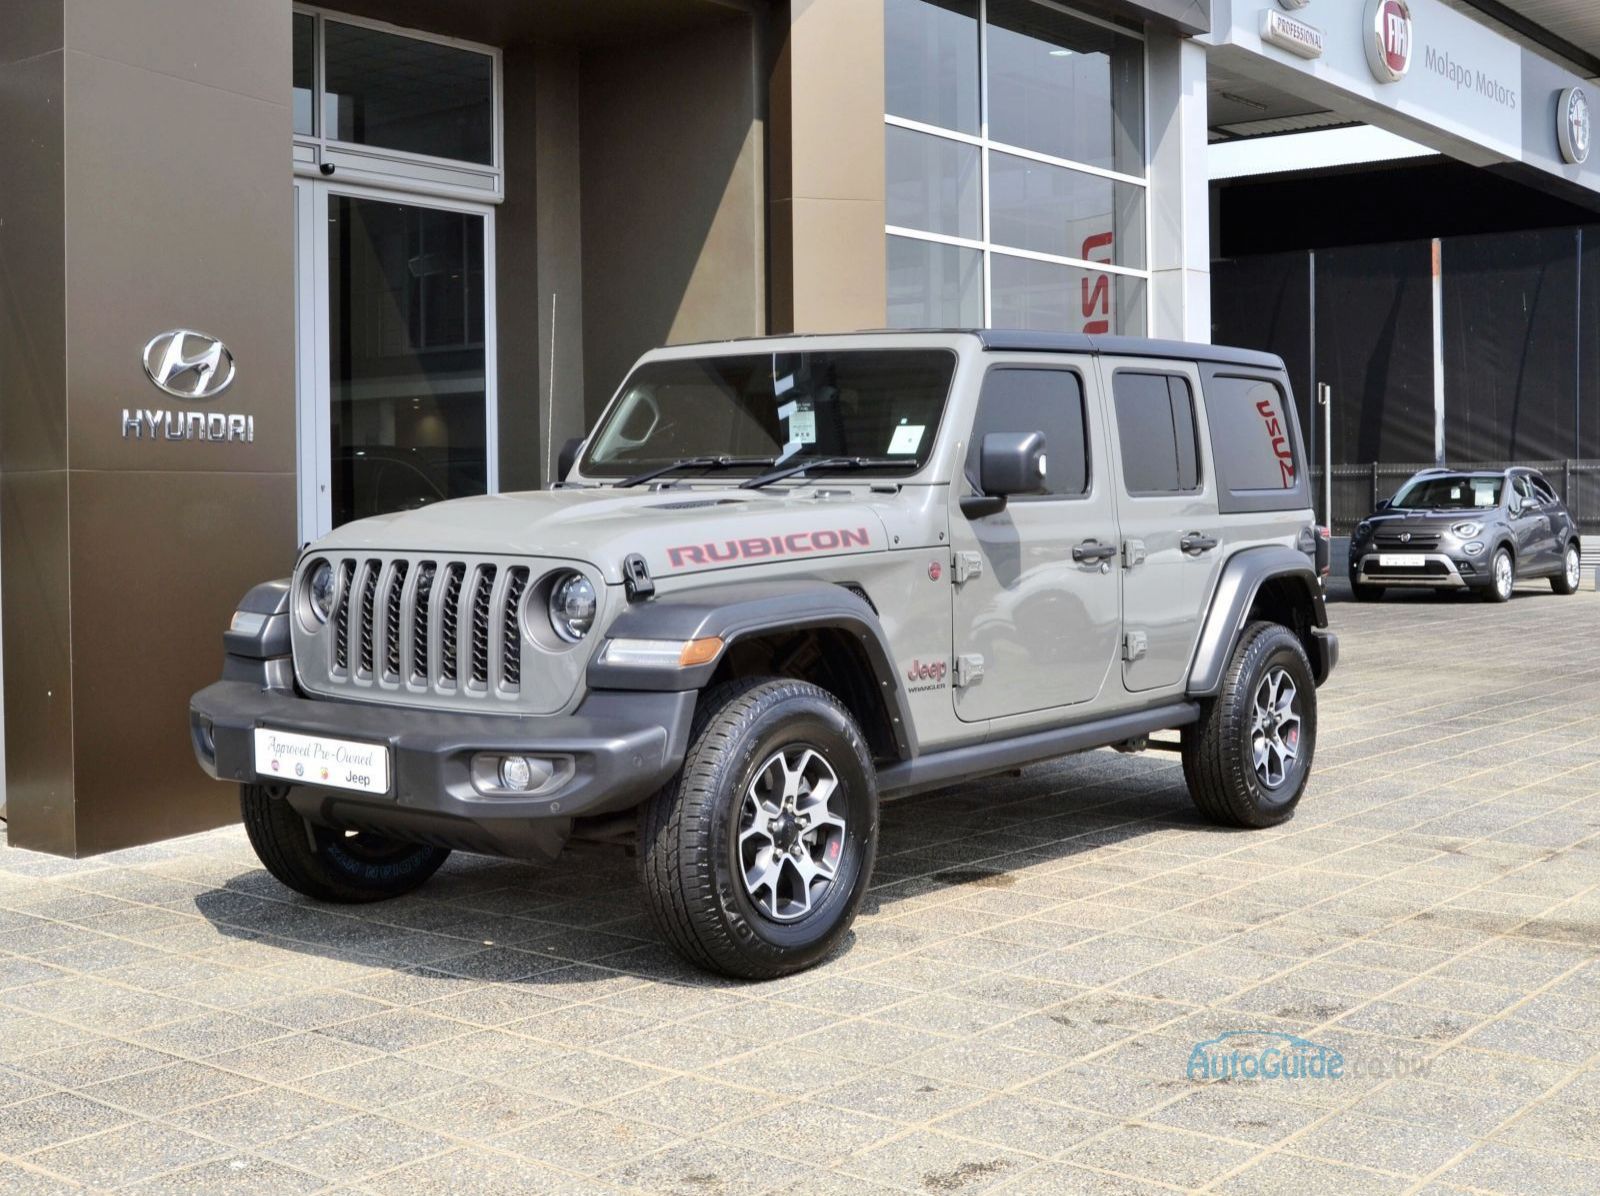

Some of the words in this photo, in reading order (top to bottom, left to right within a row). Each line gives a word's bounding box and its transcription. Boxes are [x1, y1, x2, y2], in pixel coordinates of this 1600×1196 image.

[1277, 17, 1322, 49] PROFESSIONAL
[1425, 44, 1472, 91] Molapo
[1475, 70, 1516, 109] Motors
[122, 408, 254, 442] HYUNDAI
[667, 527, 871, 568] RUBICON
[908, 659, 947, 682] Jeep
[267, 735, 310, 758] Approved
[313, 742, 373, 766] Pre-Owned
[345, 770, 371, 787] Jeep
